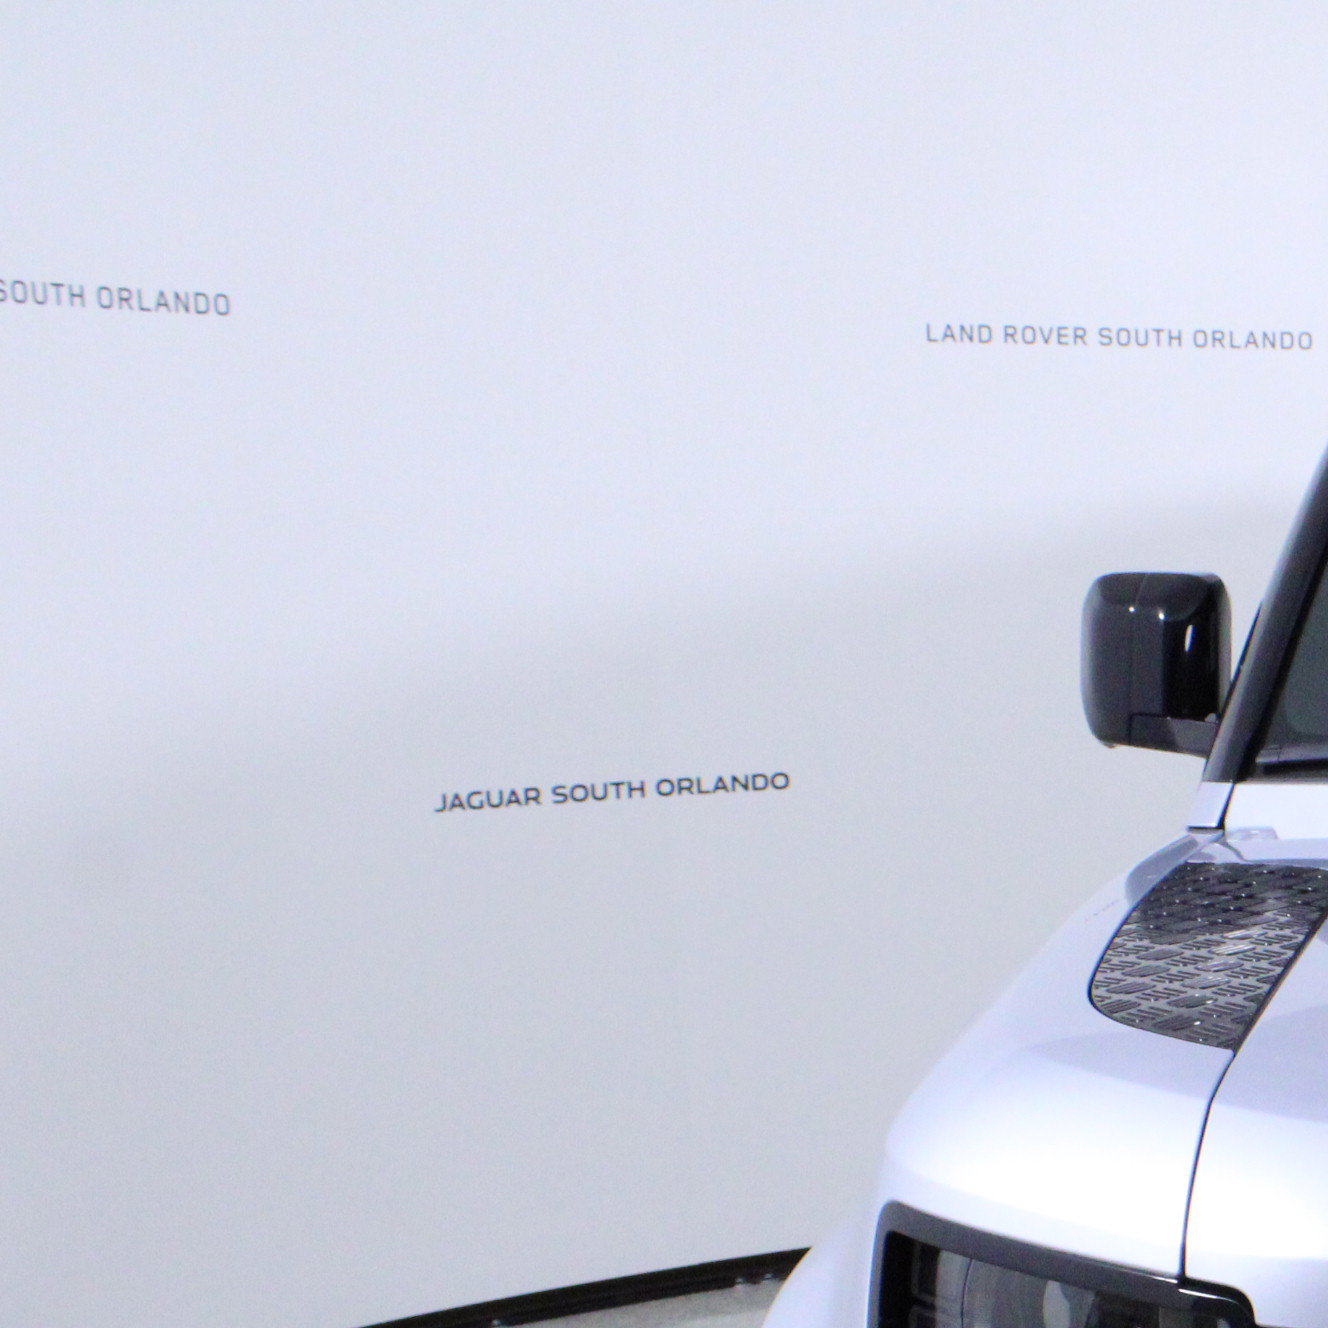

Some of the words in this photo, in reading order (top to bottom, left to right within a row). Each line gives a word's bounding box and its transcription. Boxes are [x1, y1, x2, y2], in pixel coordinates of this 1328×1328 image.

[96, 285, 231, 316] ORLANDO
[926, 323, 993, 344] LAND
[1003, 324, 1088, 346] ROVER
[1099, 326, 1183, 348] SOUTH
[1193, 329, 1313, 351] ORLANDO
[434, 786, 543, 813] JAGUAR
[551, 779, 646, 805] SOUTH
[655, 771, 791, 797] ORLANDO
